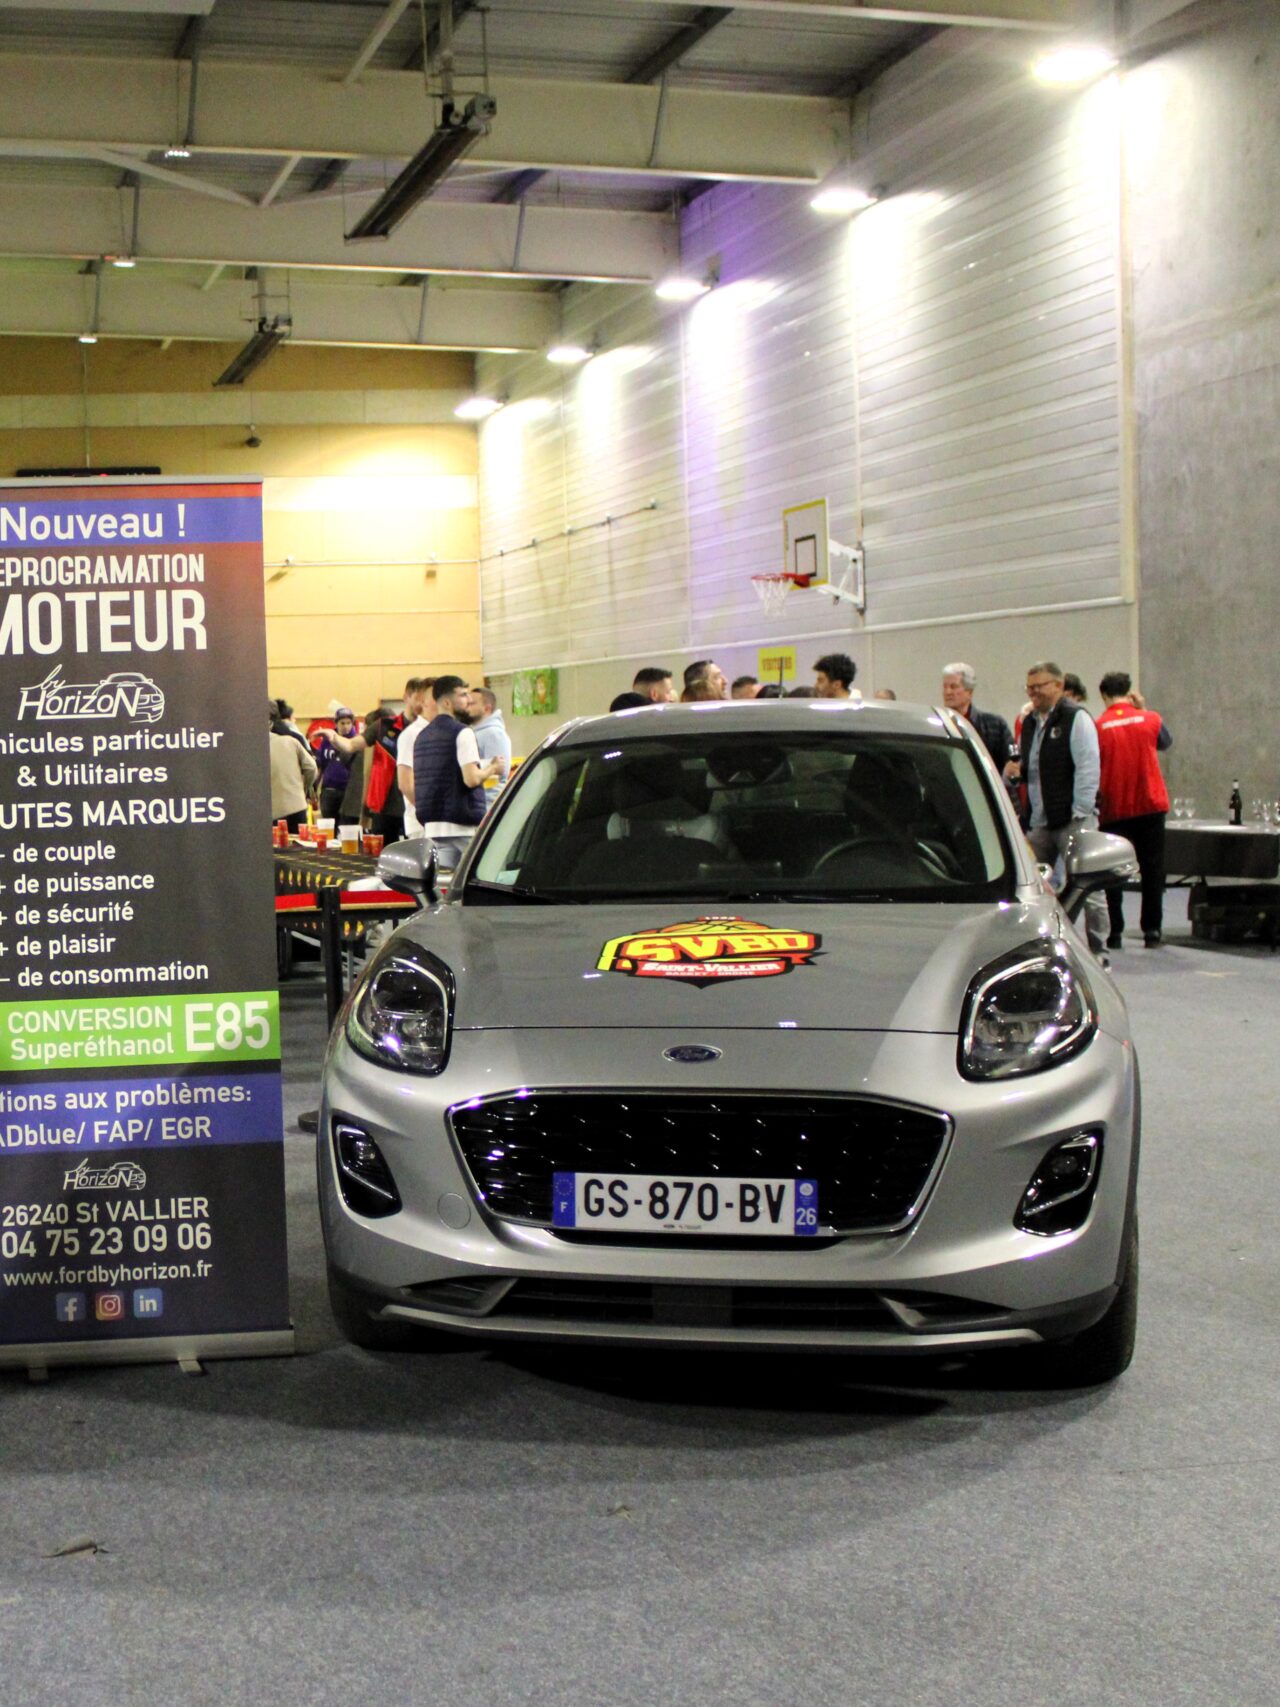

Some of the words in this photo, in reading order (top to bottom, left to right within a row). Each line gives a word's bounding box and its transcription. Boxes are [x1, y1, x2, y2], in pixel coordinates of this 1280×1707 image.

[0, 506, 164, 542] Nouveau
[177, 503, 186, 537] !
[93, 728, 224, 756] particulier
[17, 766, 37, 787] &
[45, 764, 168, 785] Utilitaires
[83, 797, 226, 826] MARQUES
[13, 843, 38, 862] de
[45, 840, 116, 865] couple
[14, 874, 39, 893] de
[46, 872, 155, 897] puissance
[15, 905, 40, 924] de
[47, 901, 134, 924] sécurité
[16, 936, 41, 955] de
[48, 933, 116, 960] plaisir
[625, 933, 809, 961] SVBD
[18, 967, 43, 987] de
[50, 961, 209, 986] consommation
[7, 1006, 172, 1034] CONVERSION
[185, 1001, 270, 1052] E85
[10, 1034, 174, 1064] Superéthanol
[65, 1092, 108, 1109] aux
[116, 1083, 252, 1113] problèmes:
[94, 1118, 154, 1143] FAP/
[161, 1117, 212, 1140] EGR
[2, 1203, 69, 1228] 26240
[76, 1202, 100, 1223] St
[106, 1197, 209, 1222] VALLIER
[560, 1202, 568, 1213] F
[584, 1178, 786, 1224] GS-870-BV
[796, 1207, 816, 1226] 26
[1, 1231, 36, 1259] 04
[46, 1228, 80, 1256] 75
[90, 1227, 123, 1255] 23
[133, 1225, 167, 1252] 09
[177, 1223, 212, 1250] 06
[3, 1260, 213, 1287] www.fordbyhorizon.fr
